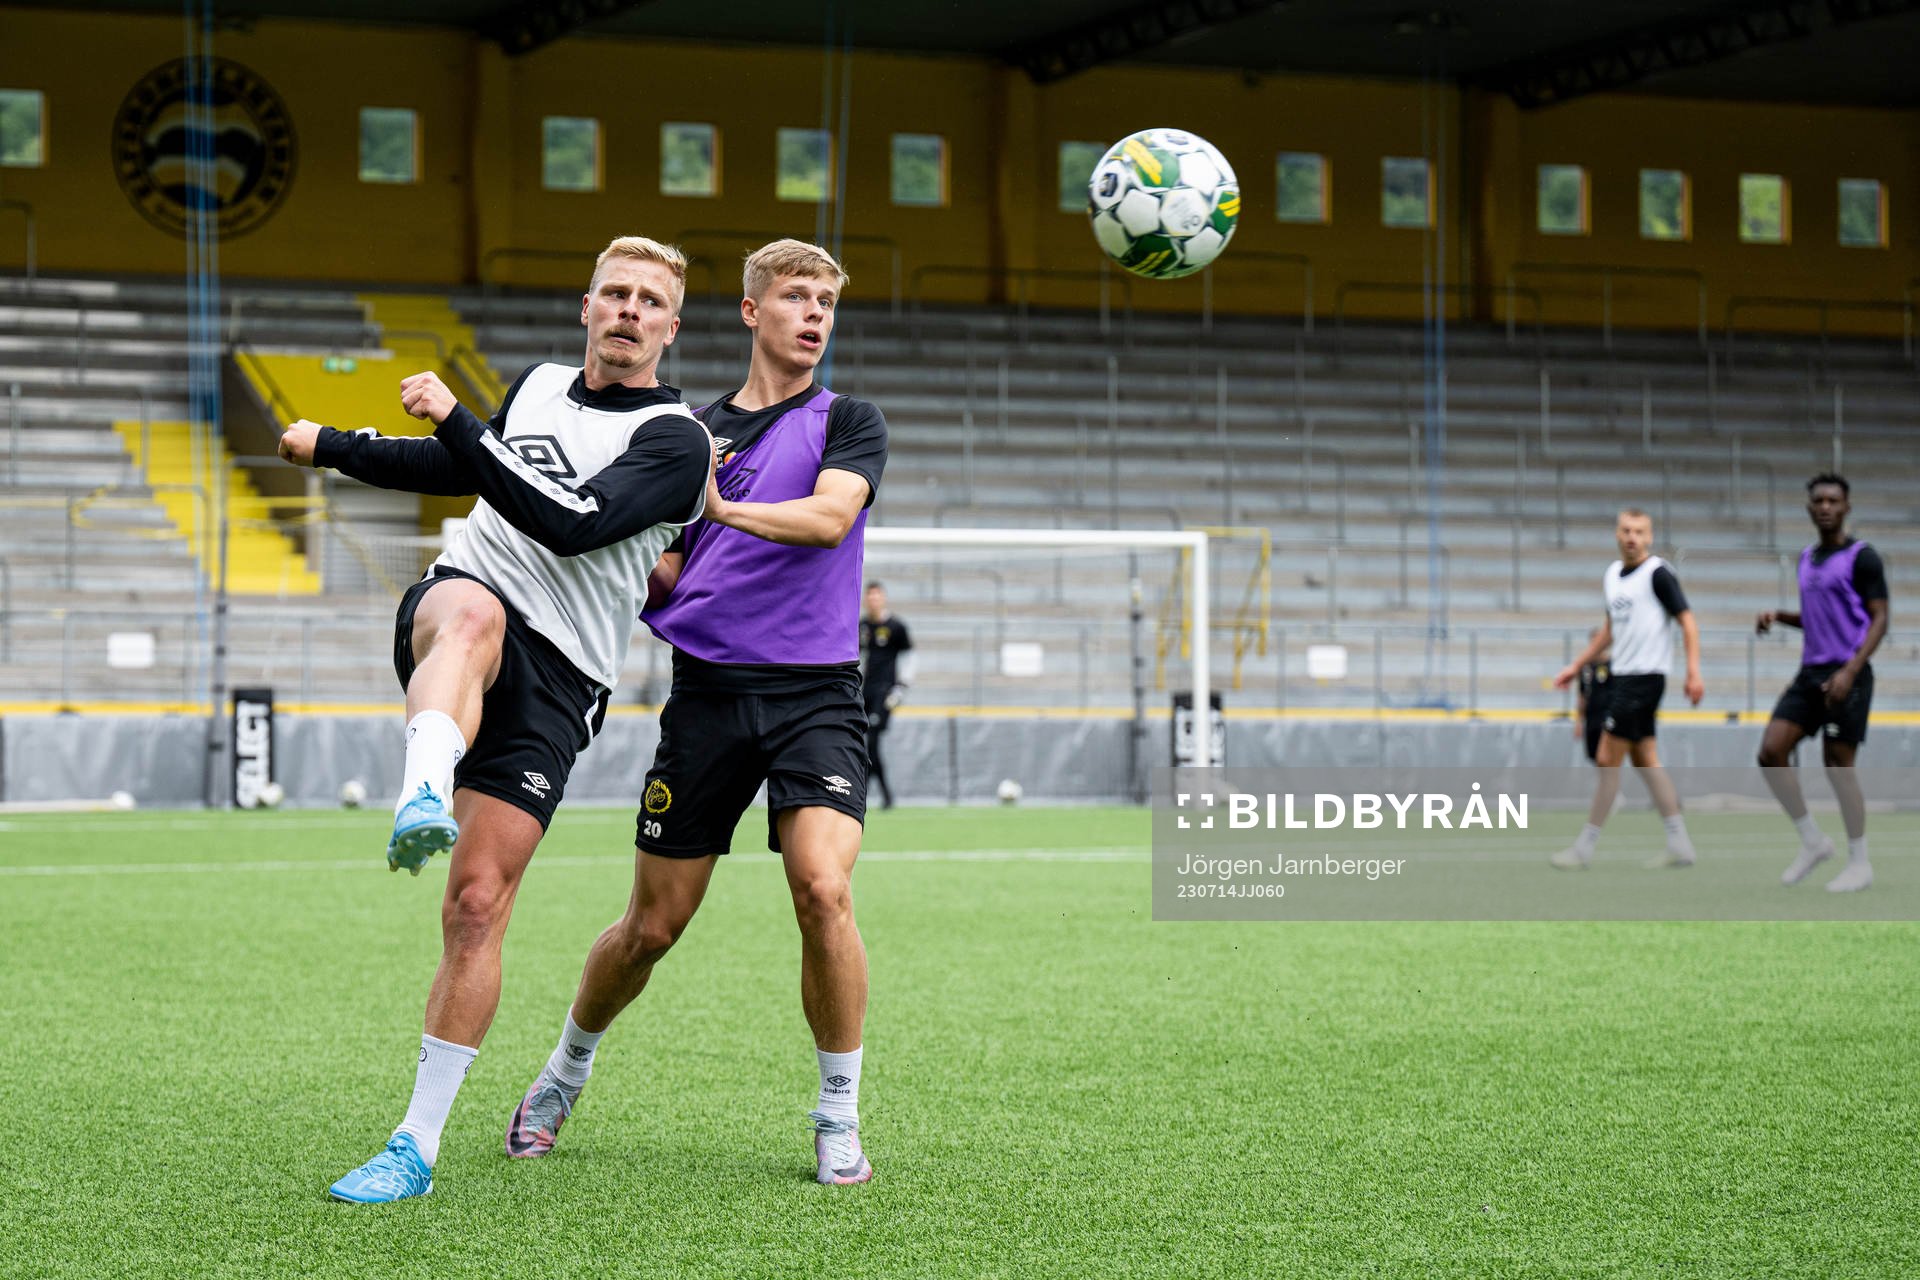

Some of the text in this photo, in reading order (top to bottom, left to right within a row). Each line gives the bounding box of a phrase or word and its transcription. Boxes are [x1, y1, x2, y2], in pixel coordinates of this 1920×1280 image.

[521, 782, 546, 799] umbro
[825, 785, 850, 795] umbro
[644, 819, 662, 838] 20
